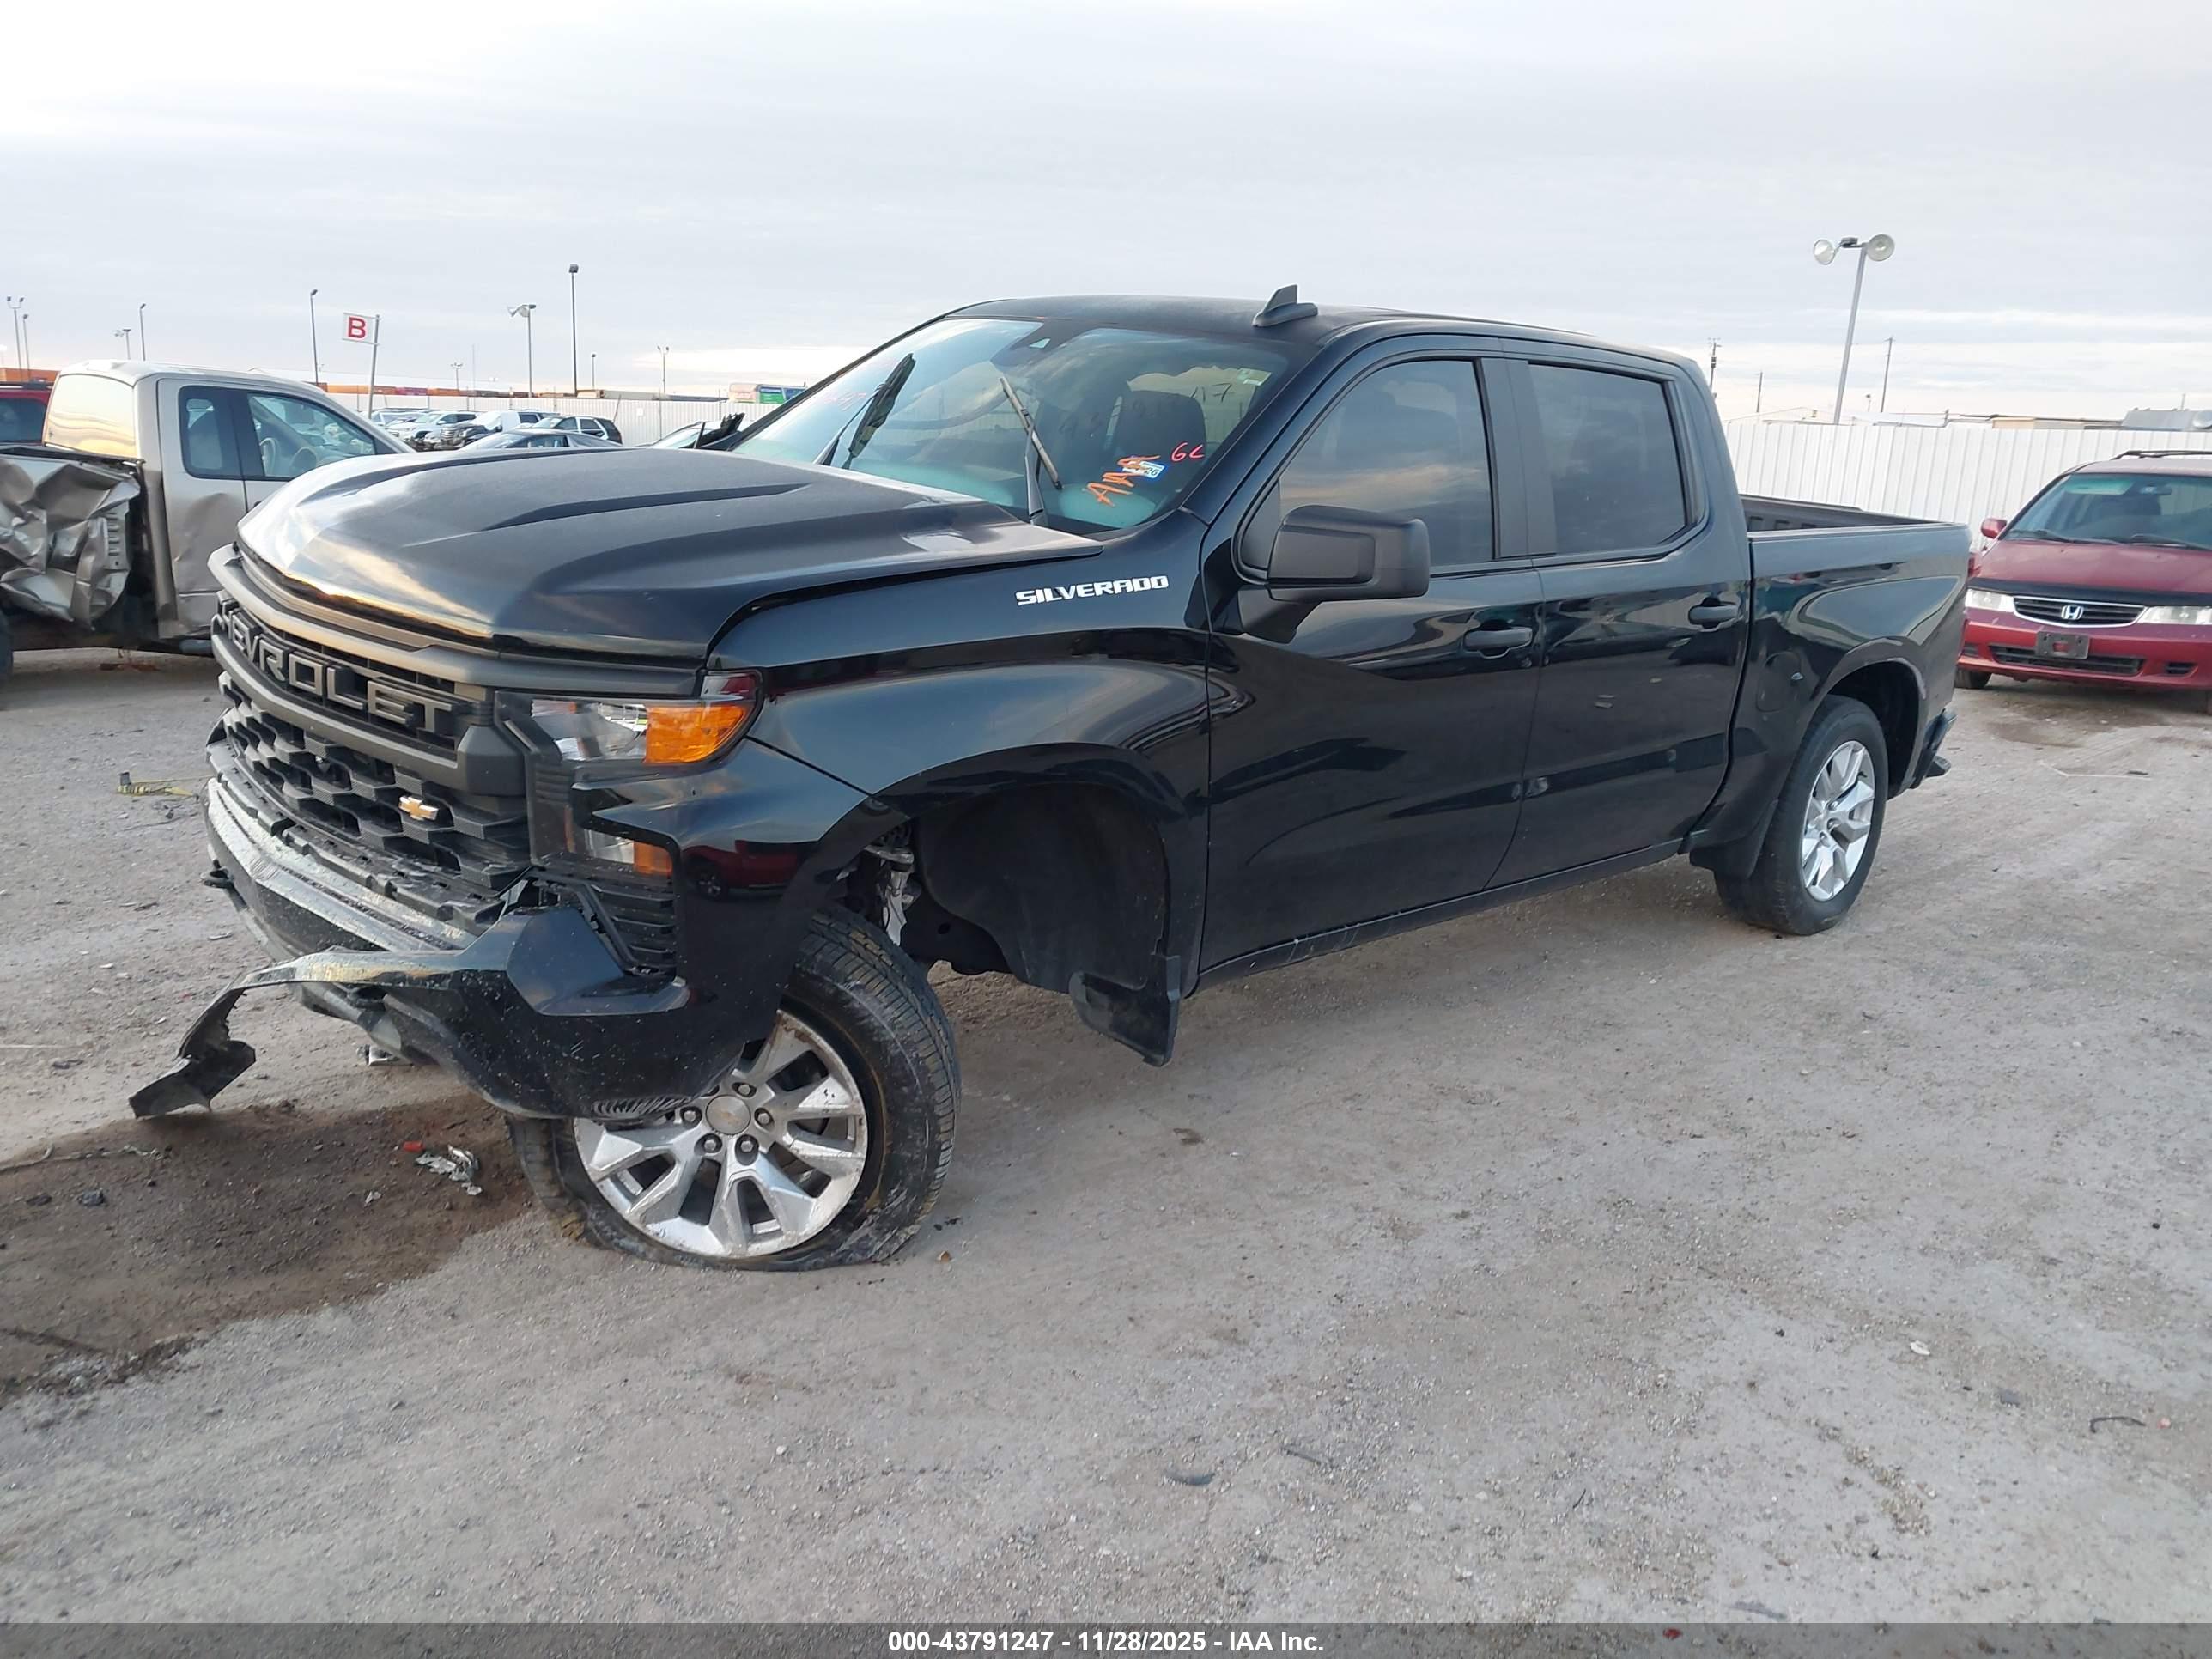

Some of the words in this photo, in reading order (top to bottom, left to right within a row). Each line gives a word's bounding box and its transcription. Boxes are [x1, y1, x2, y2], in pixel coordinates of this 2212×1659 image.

[348, 316, 366, 339] B
[1016, 575, 1169, 605] SILVERADO
[222, 602, 453, 732] HEVROLET
